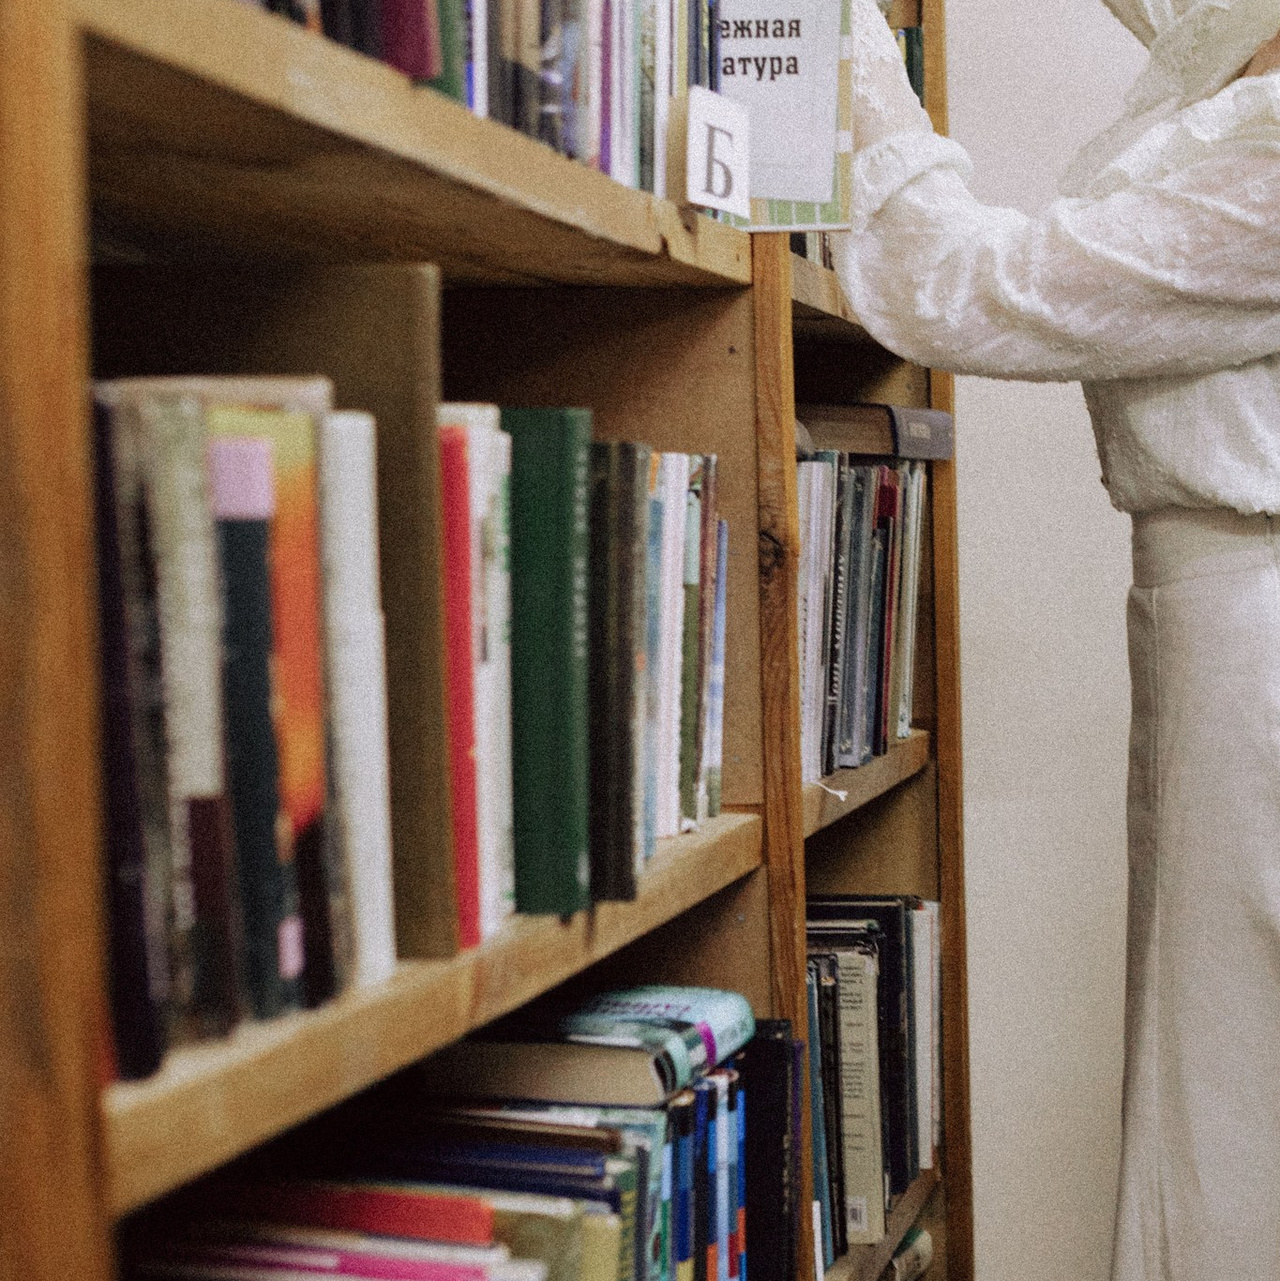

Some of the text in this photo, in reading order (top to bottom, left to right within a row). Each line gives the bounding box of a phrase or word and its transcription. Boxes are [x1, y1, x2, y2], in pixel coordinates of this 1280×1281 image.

[720, 17, 802, 39] ежная
[722, 54, 800, 80] атура
[702, 123, 733, 201] Б
